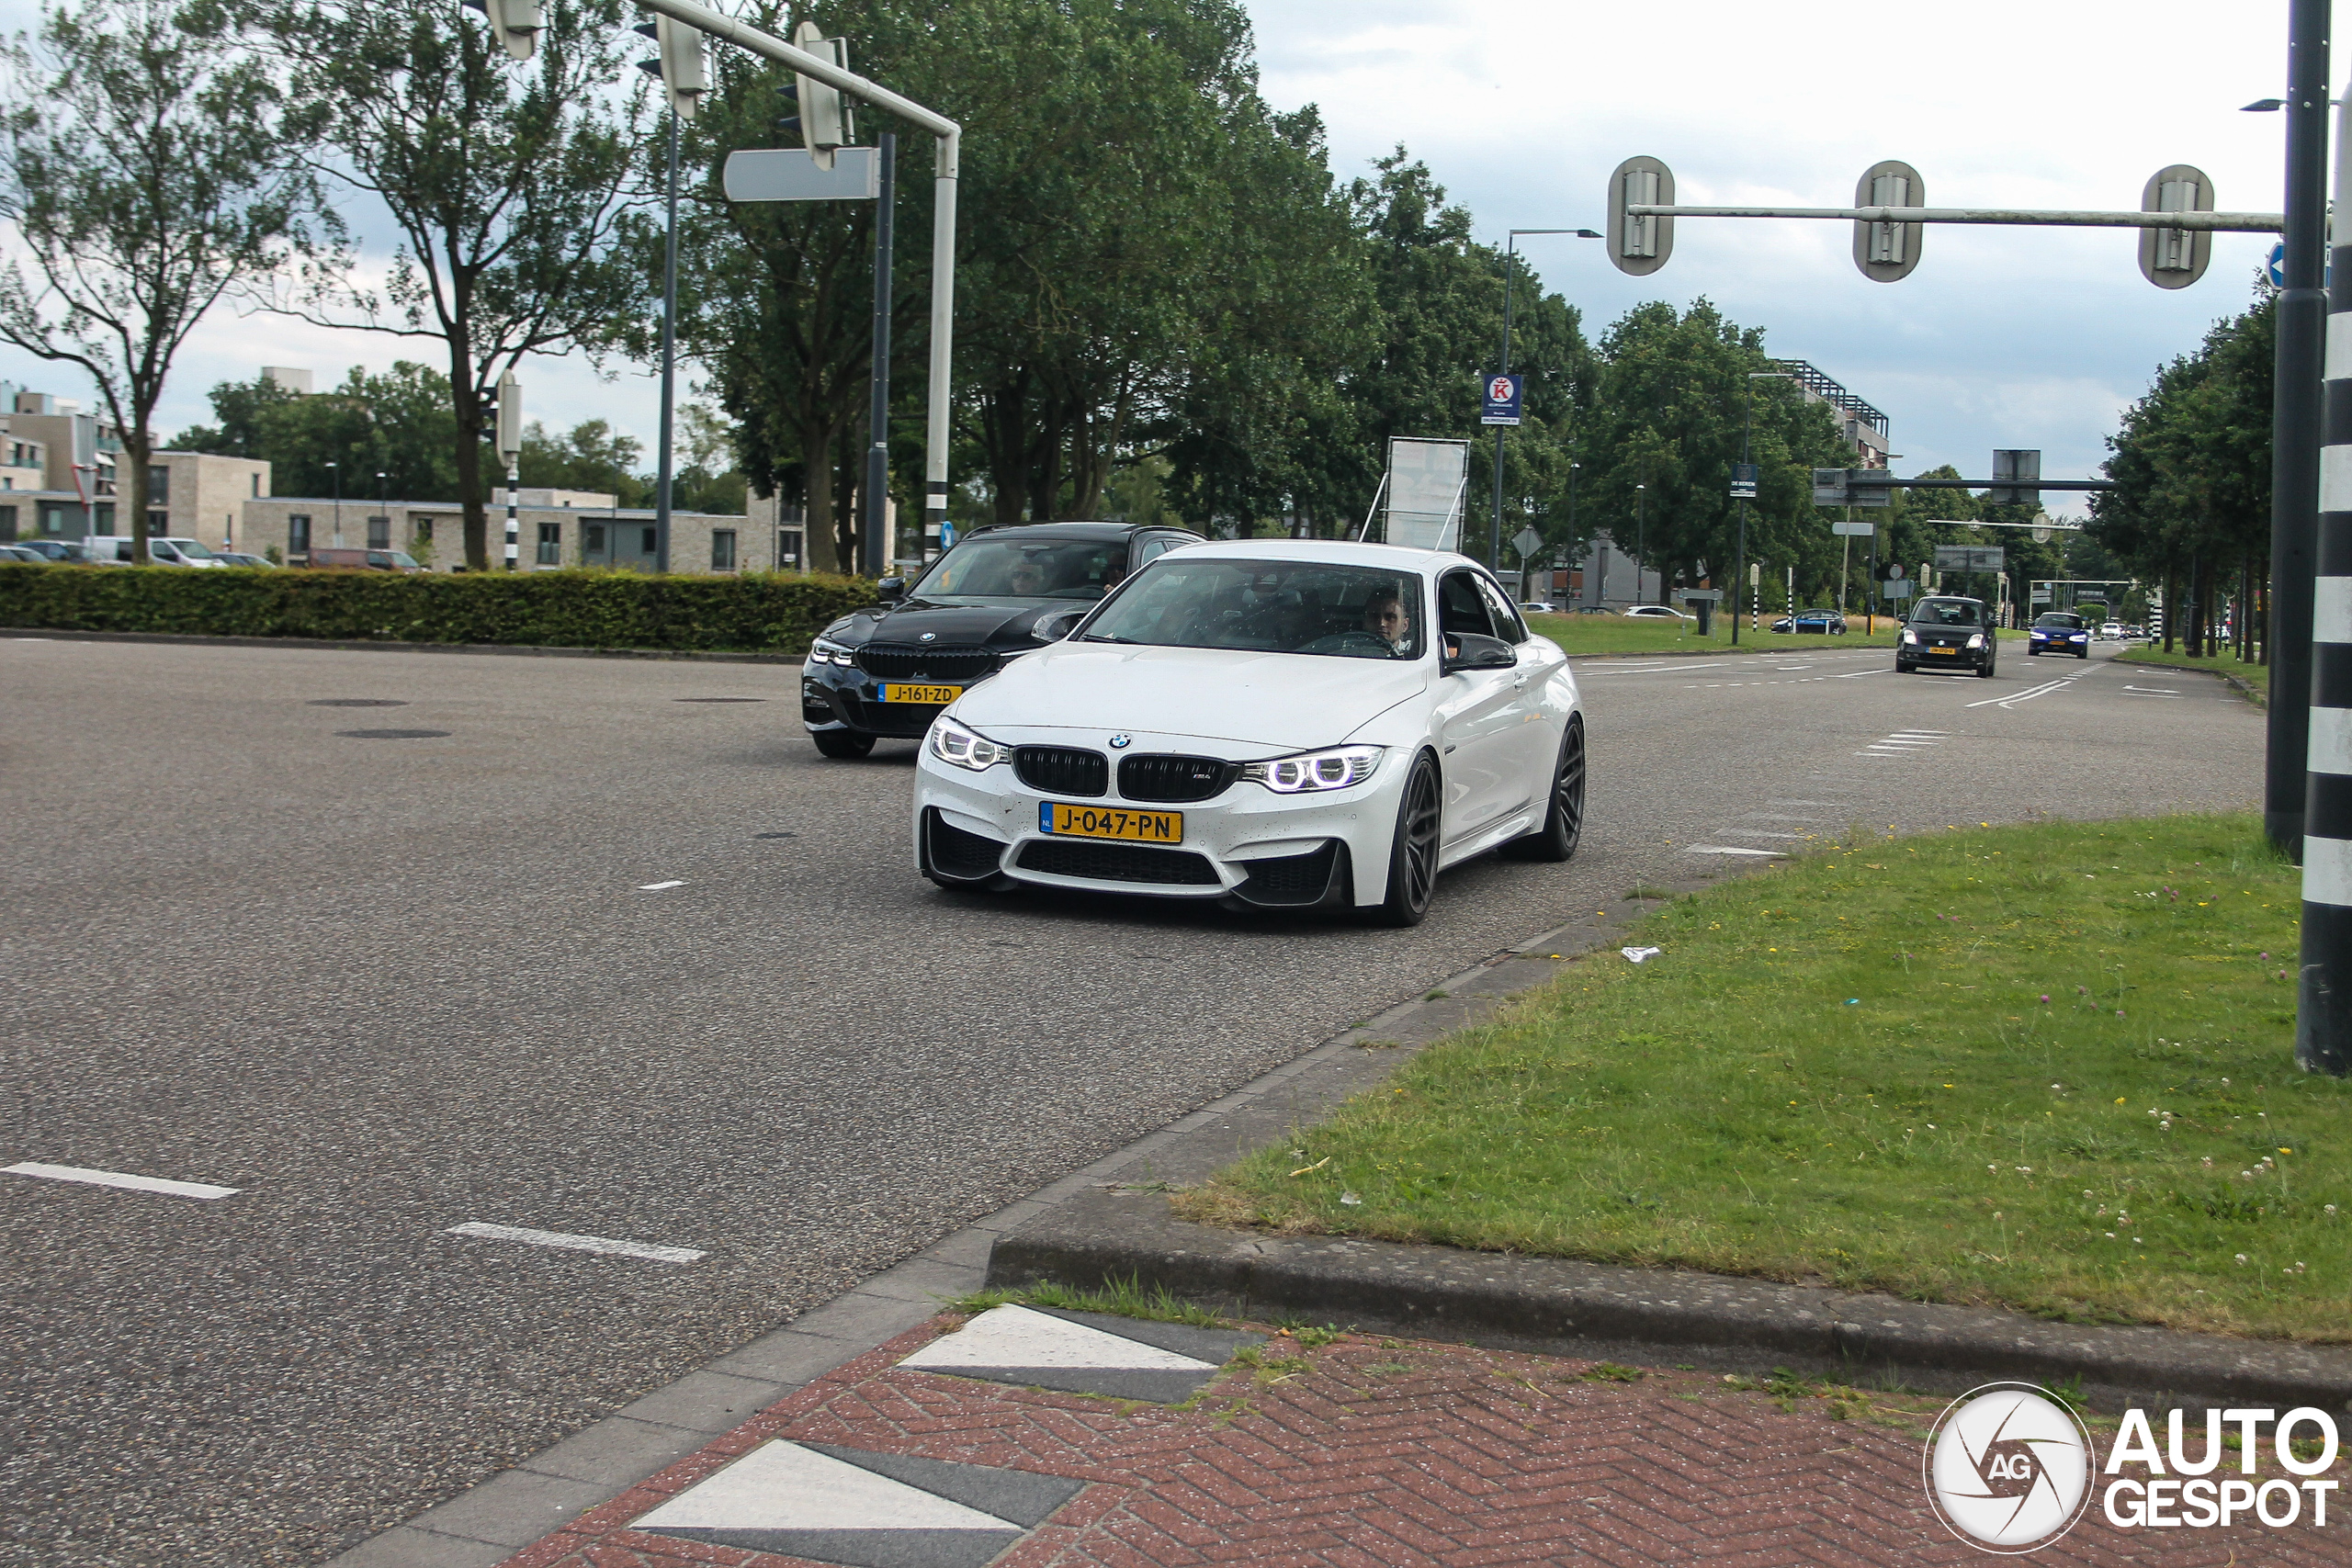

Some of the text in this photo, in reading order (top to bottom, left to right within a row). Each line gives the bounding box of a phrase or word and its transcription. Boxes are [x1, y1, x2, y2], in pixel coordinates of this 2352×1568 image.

[1493, 384, 1509, 399] K
[895, 687, 952, 701] J-161-ZD
[1061, 809, 1170, 838] J-047-PN
